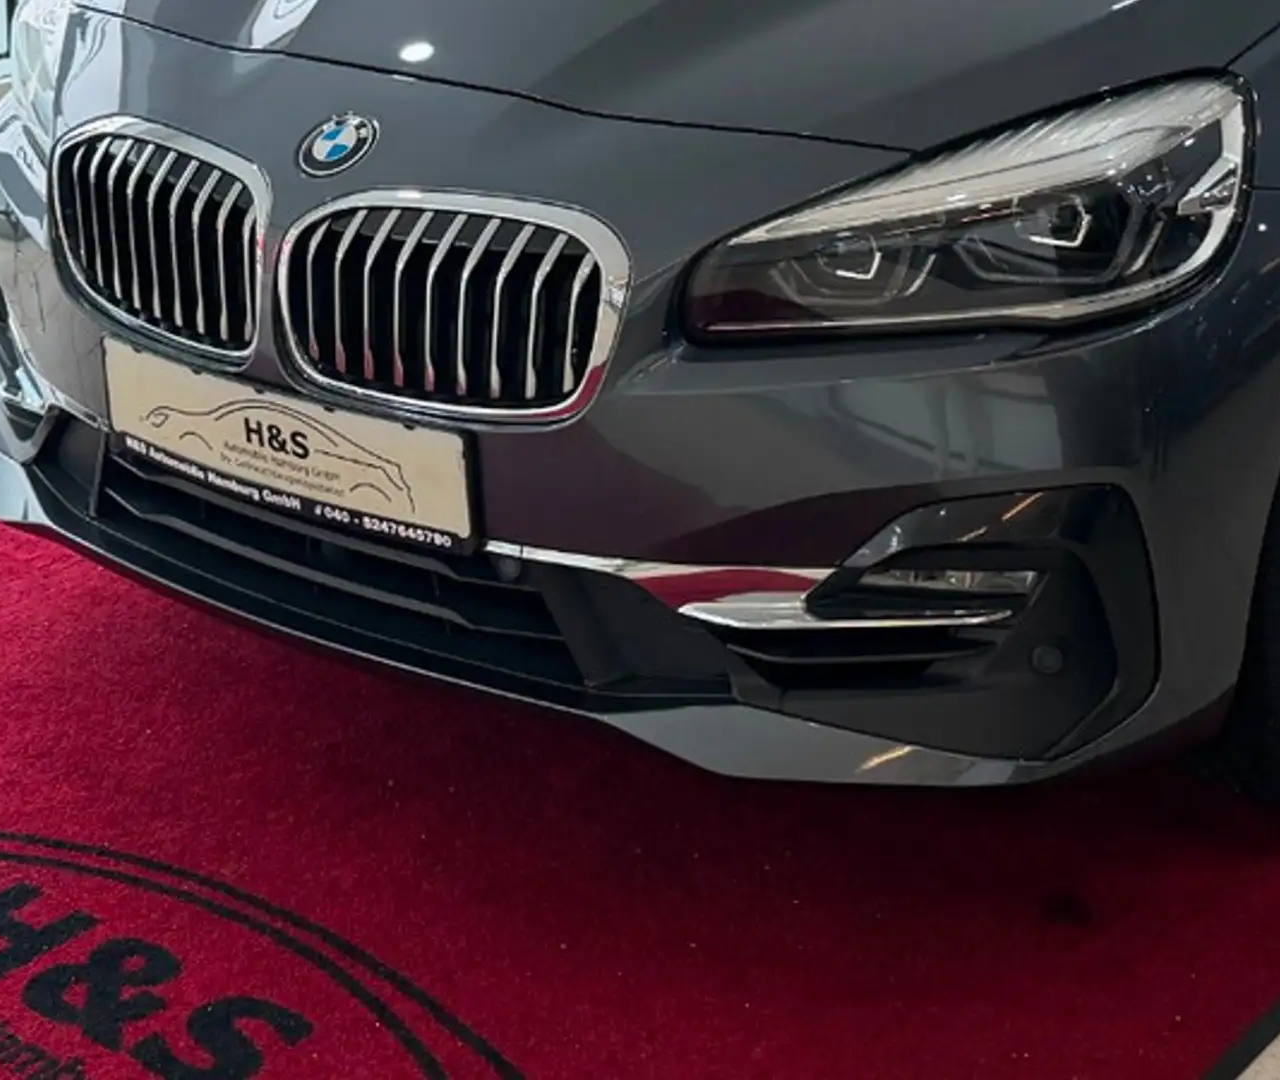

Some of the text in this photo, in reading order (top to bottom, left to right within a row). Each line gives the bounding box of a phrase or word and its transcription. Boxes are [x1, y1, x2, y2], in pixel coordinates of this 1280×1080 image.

[243, 417, 310, 460] H&S
[207, 471, 261, 501] Hamburg
[262, 489, 301, 511] GmbH
